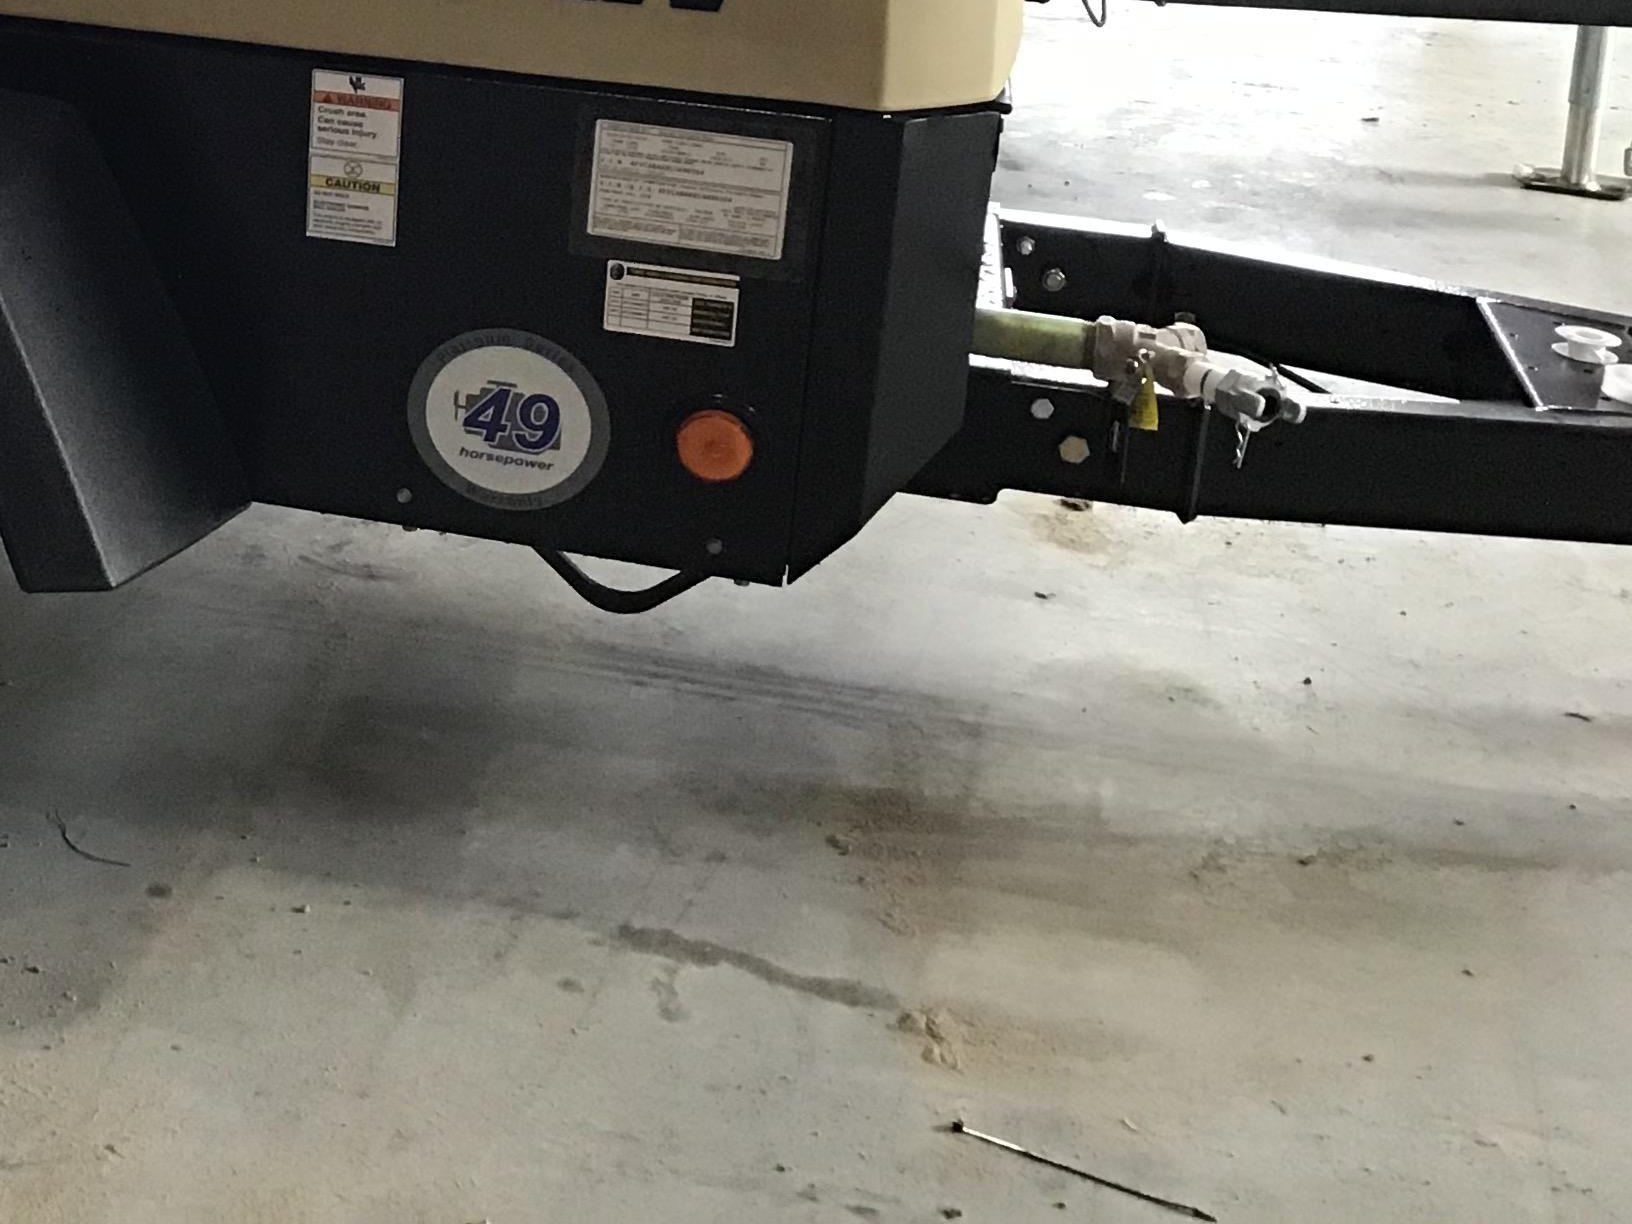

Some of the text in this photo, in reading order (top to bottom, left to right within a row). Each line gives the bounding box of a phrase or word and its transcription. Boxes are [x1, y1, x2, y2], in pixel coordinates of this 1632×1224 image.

[318, 116, 335, 124] Can
[325, 178, 380, 192] CAUTION
[463, 386, 560, 452] 49
[459, 446, 555, 472] horsepower
